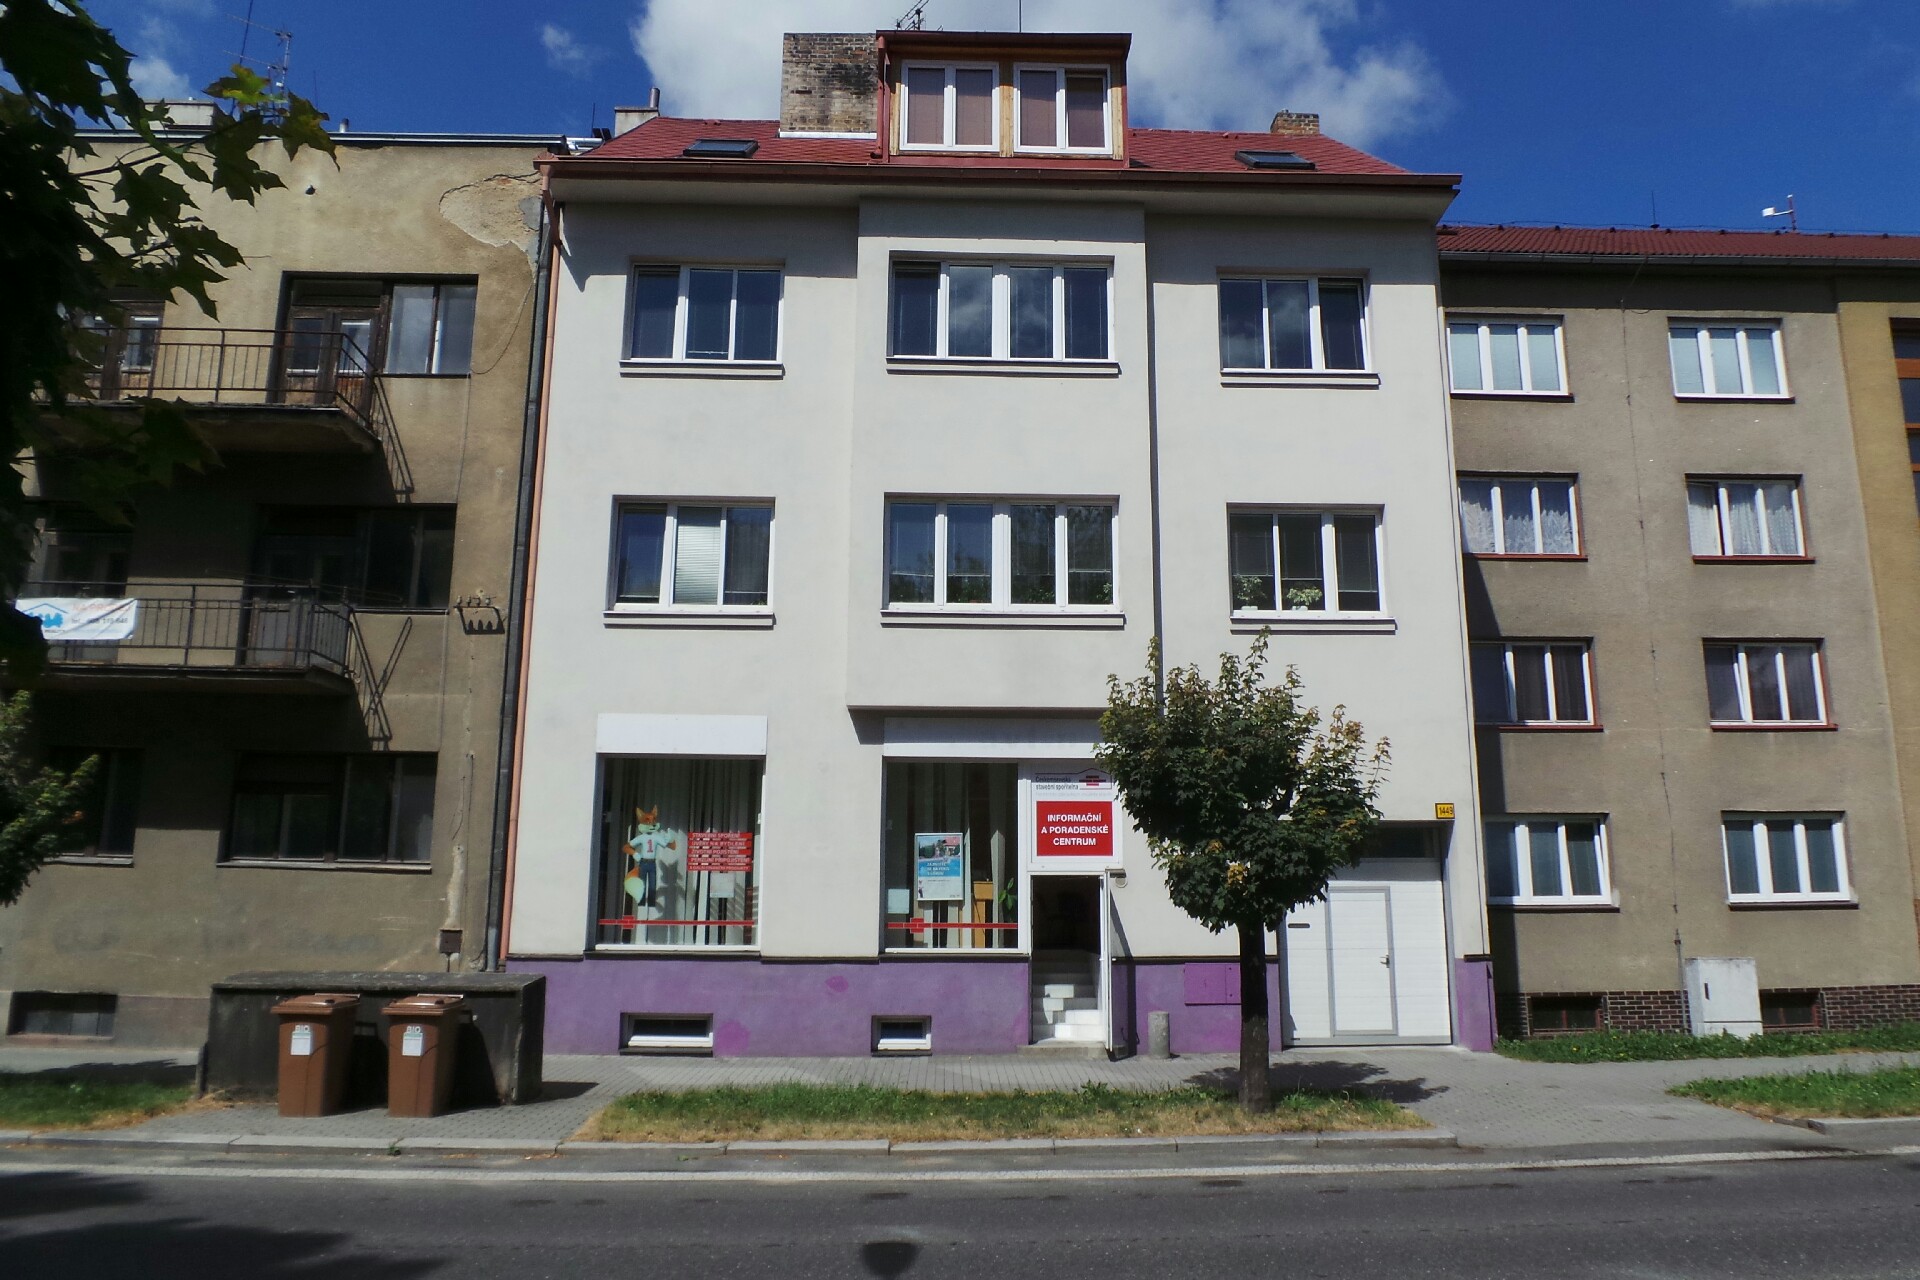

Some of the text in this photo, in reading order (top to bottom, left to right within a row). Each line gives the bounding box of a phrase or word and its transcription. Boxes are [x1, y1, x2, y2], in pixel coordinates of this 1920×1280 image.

[1048, 813, 1101, 822] INFORMAČNÍ
[1050, 824, 1108, 833] PORADENSKÉ
[406, 1025, 421, 1034] BIO
